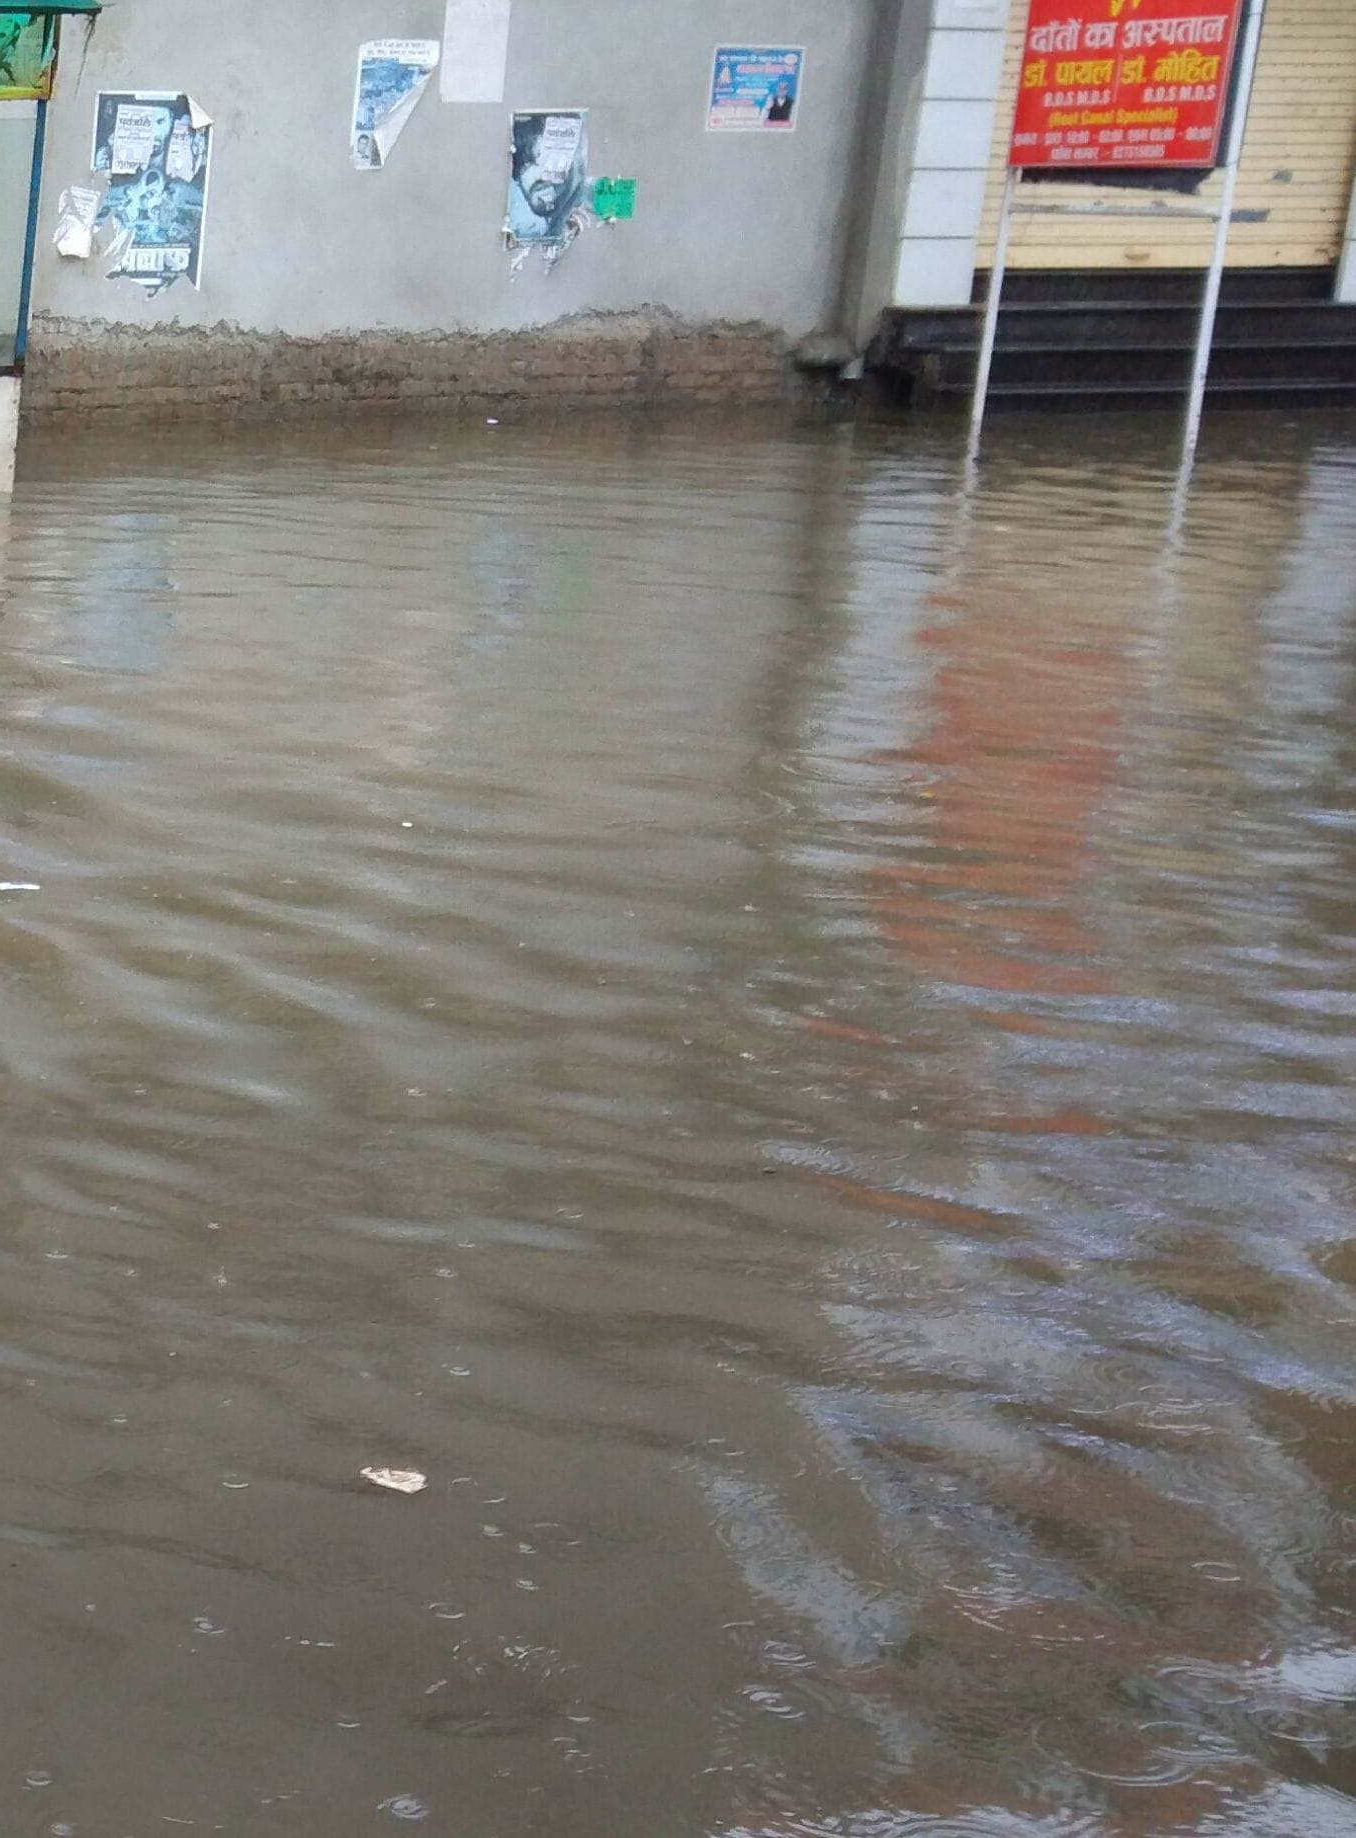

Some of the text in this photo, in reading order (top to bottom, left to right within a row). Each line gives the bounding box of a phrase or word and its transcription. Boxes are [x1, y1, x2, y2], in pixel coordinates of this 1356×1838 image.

[1085, 21, 1117, 49] का
[1122, 15, 1228, 49] अस्पताल
[1055, 59, 1114, 86] पायल
[1153, 48, 1220, 84] मोहित
